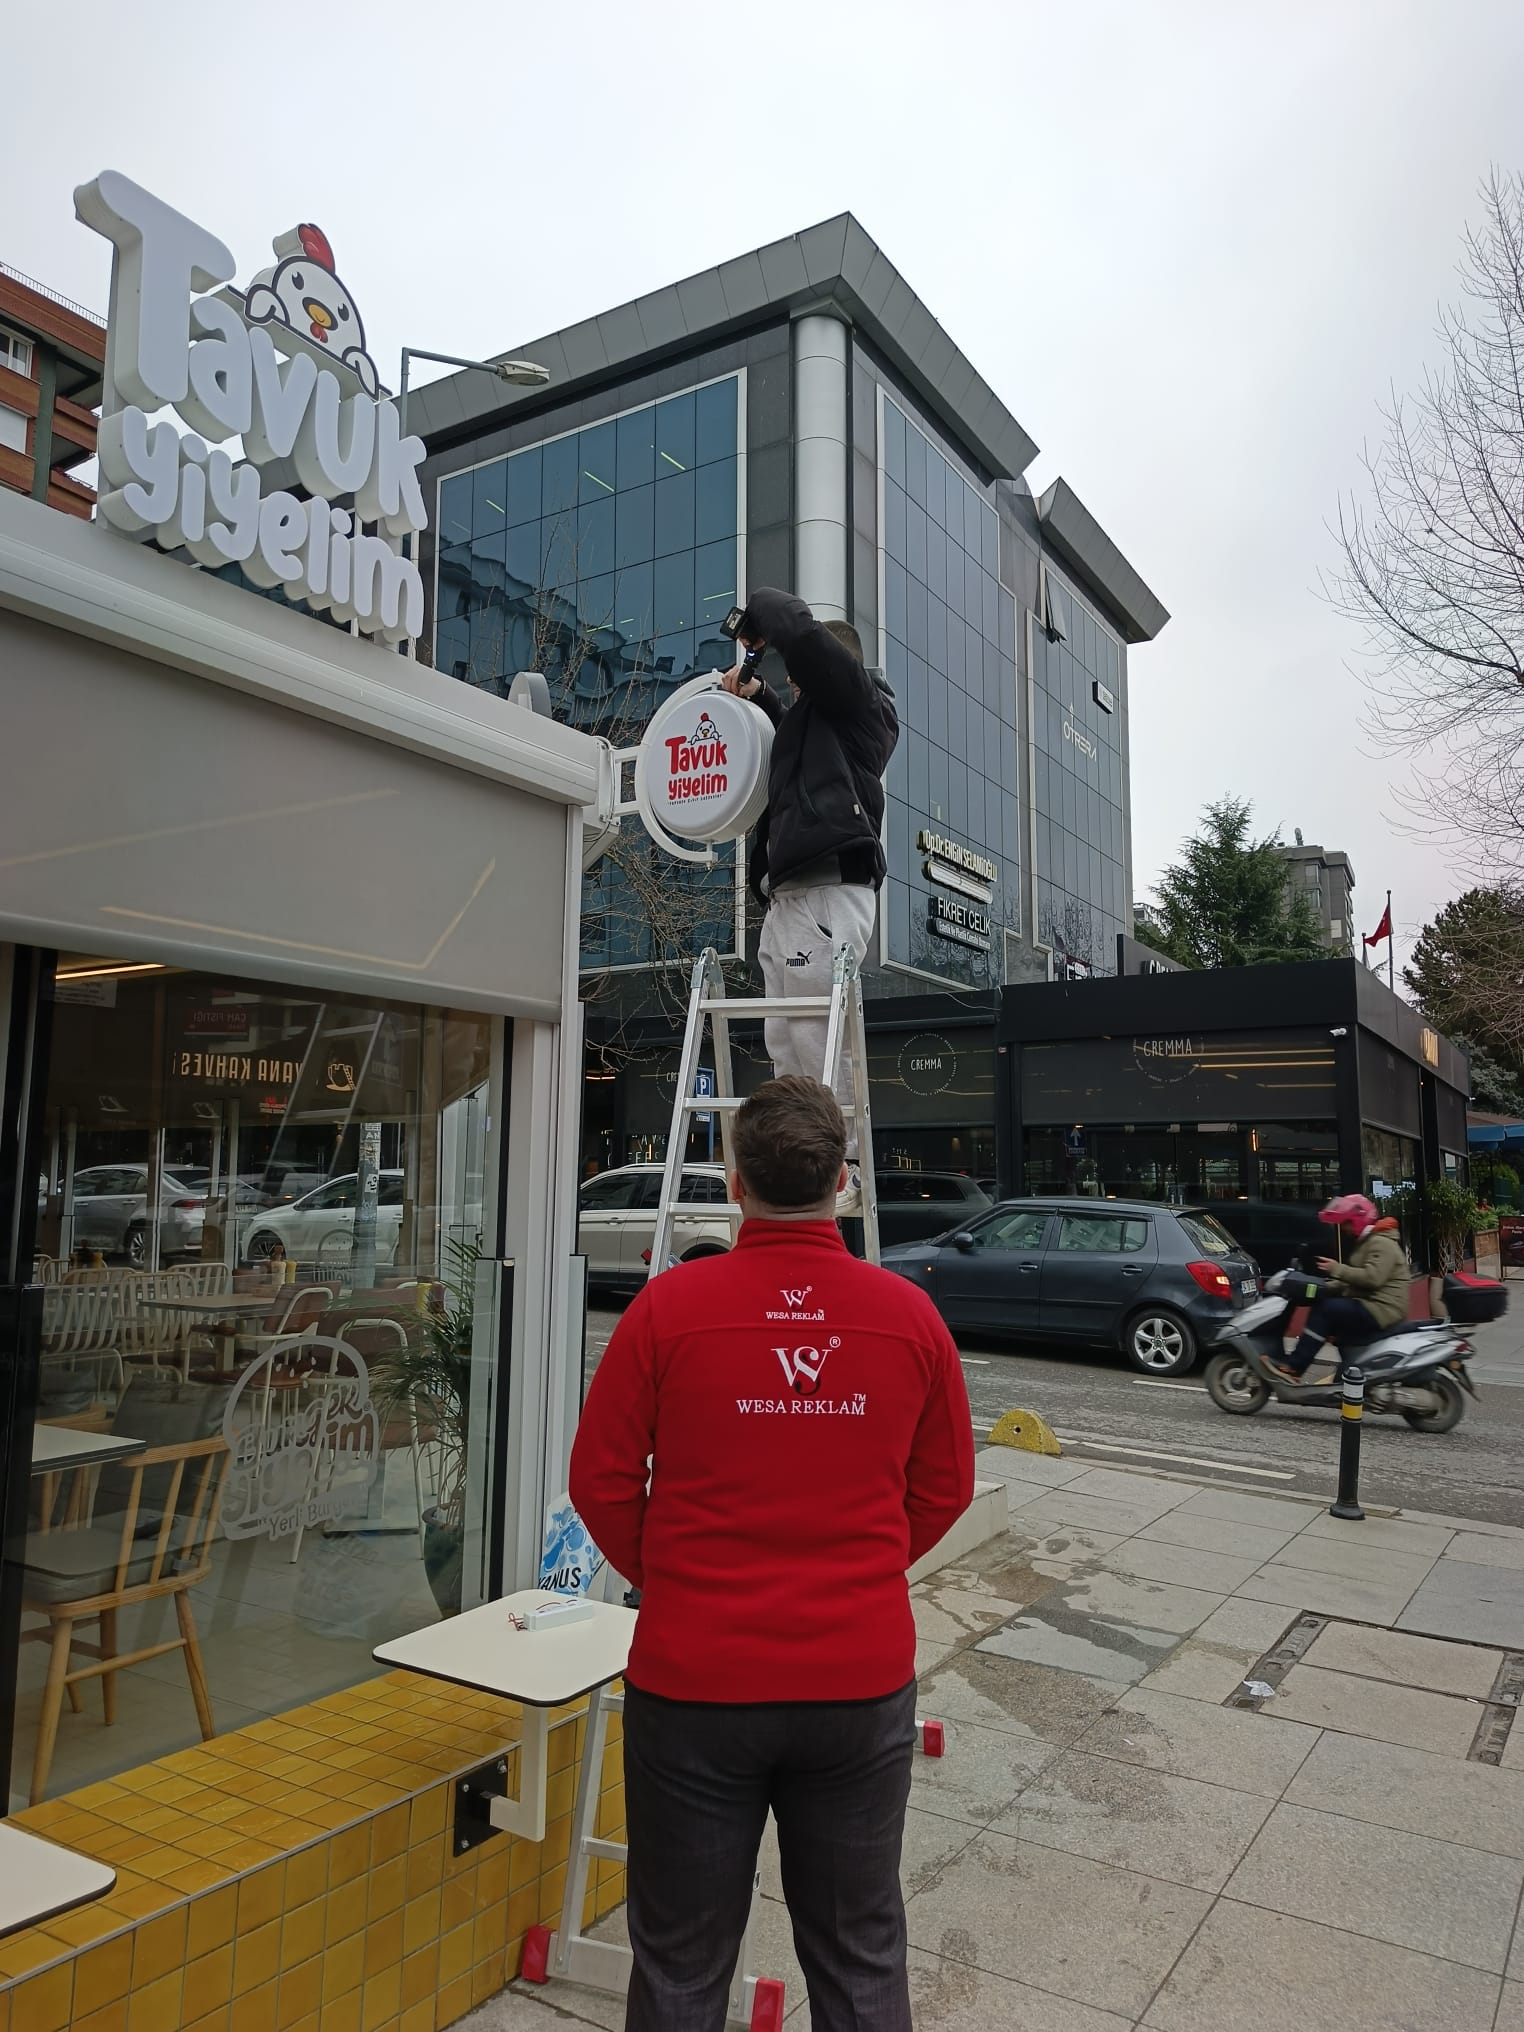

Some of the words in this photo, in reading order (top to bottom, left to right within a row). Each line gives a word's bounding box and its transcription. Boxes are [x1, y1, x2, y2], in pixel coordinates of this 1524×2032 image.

[73, 169, 428, 534] Tavuk
[98, 405, 425, 642] yiyelim
[665, 735, 728, 775] Tavuk
[668, 773, 727, 800] yiyelim
[785, 958, 806, 967] PUMA
[1143, 1038, 1192, 1057] CREMMA
[910, 1057, 942, 1071] CREMMA
[700, 1078, 707, 1095] P
[766, 1311, 790, 1320] WESA
[791, 1312, 825, 1321] REKLAM
[736, 1400, 787, 1414] WESA
[791, 1400, 866, 1415] REKLAM
